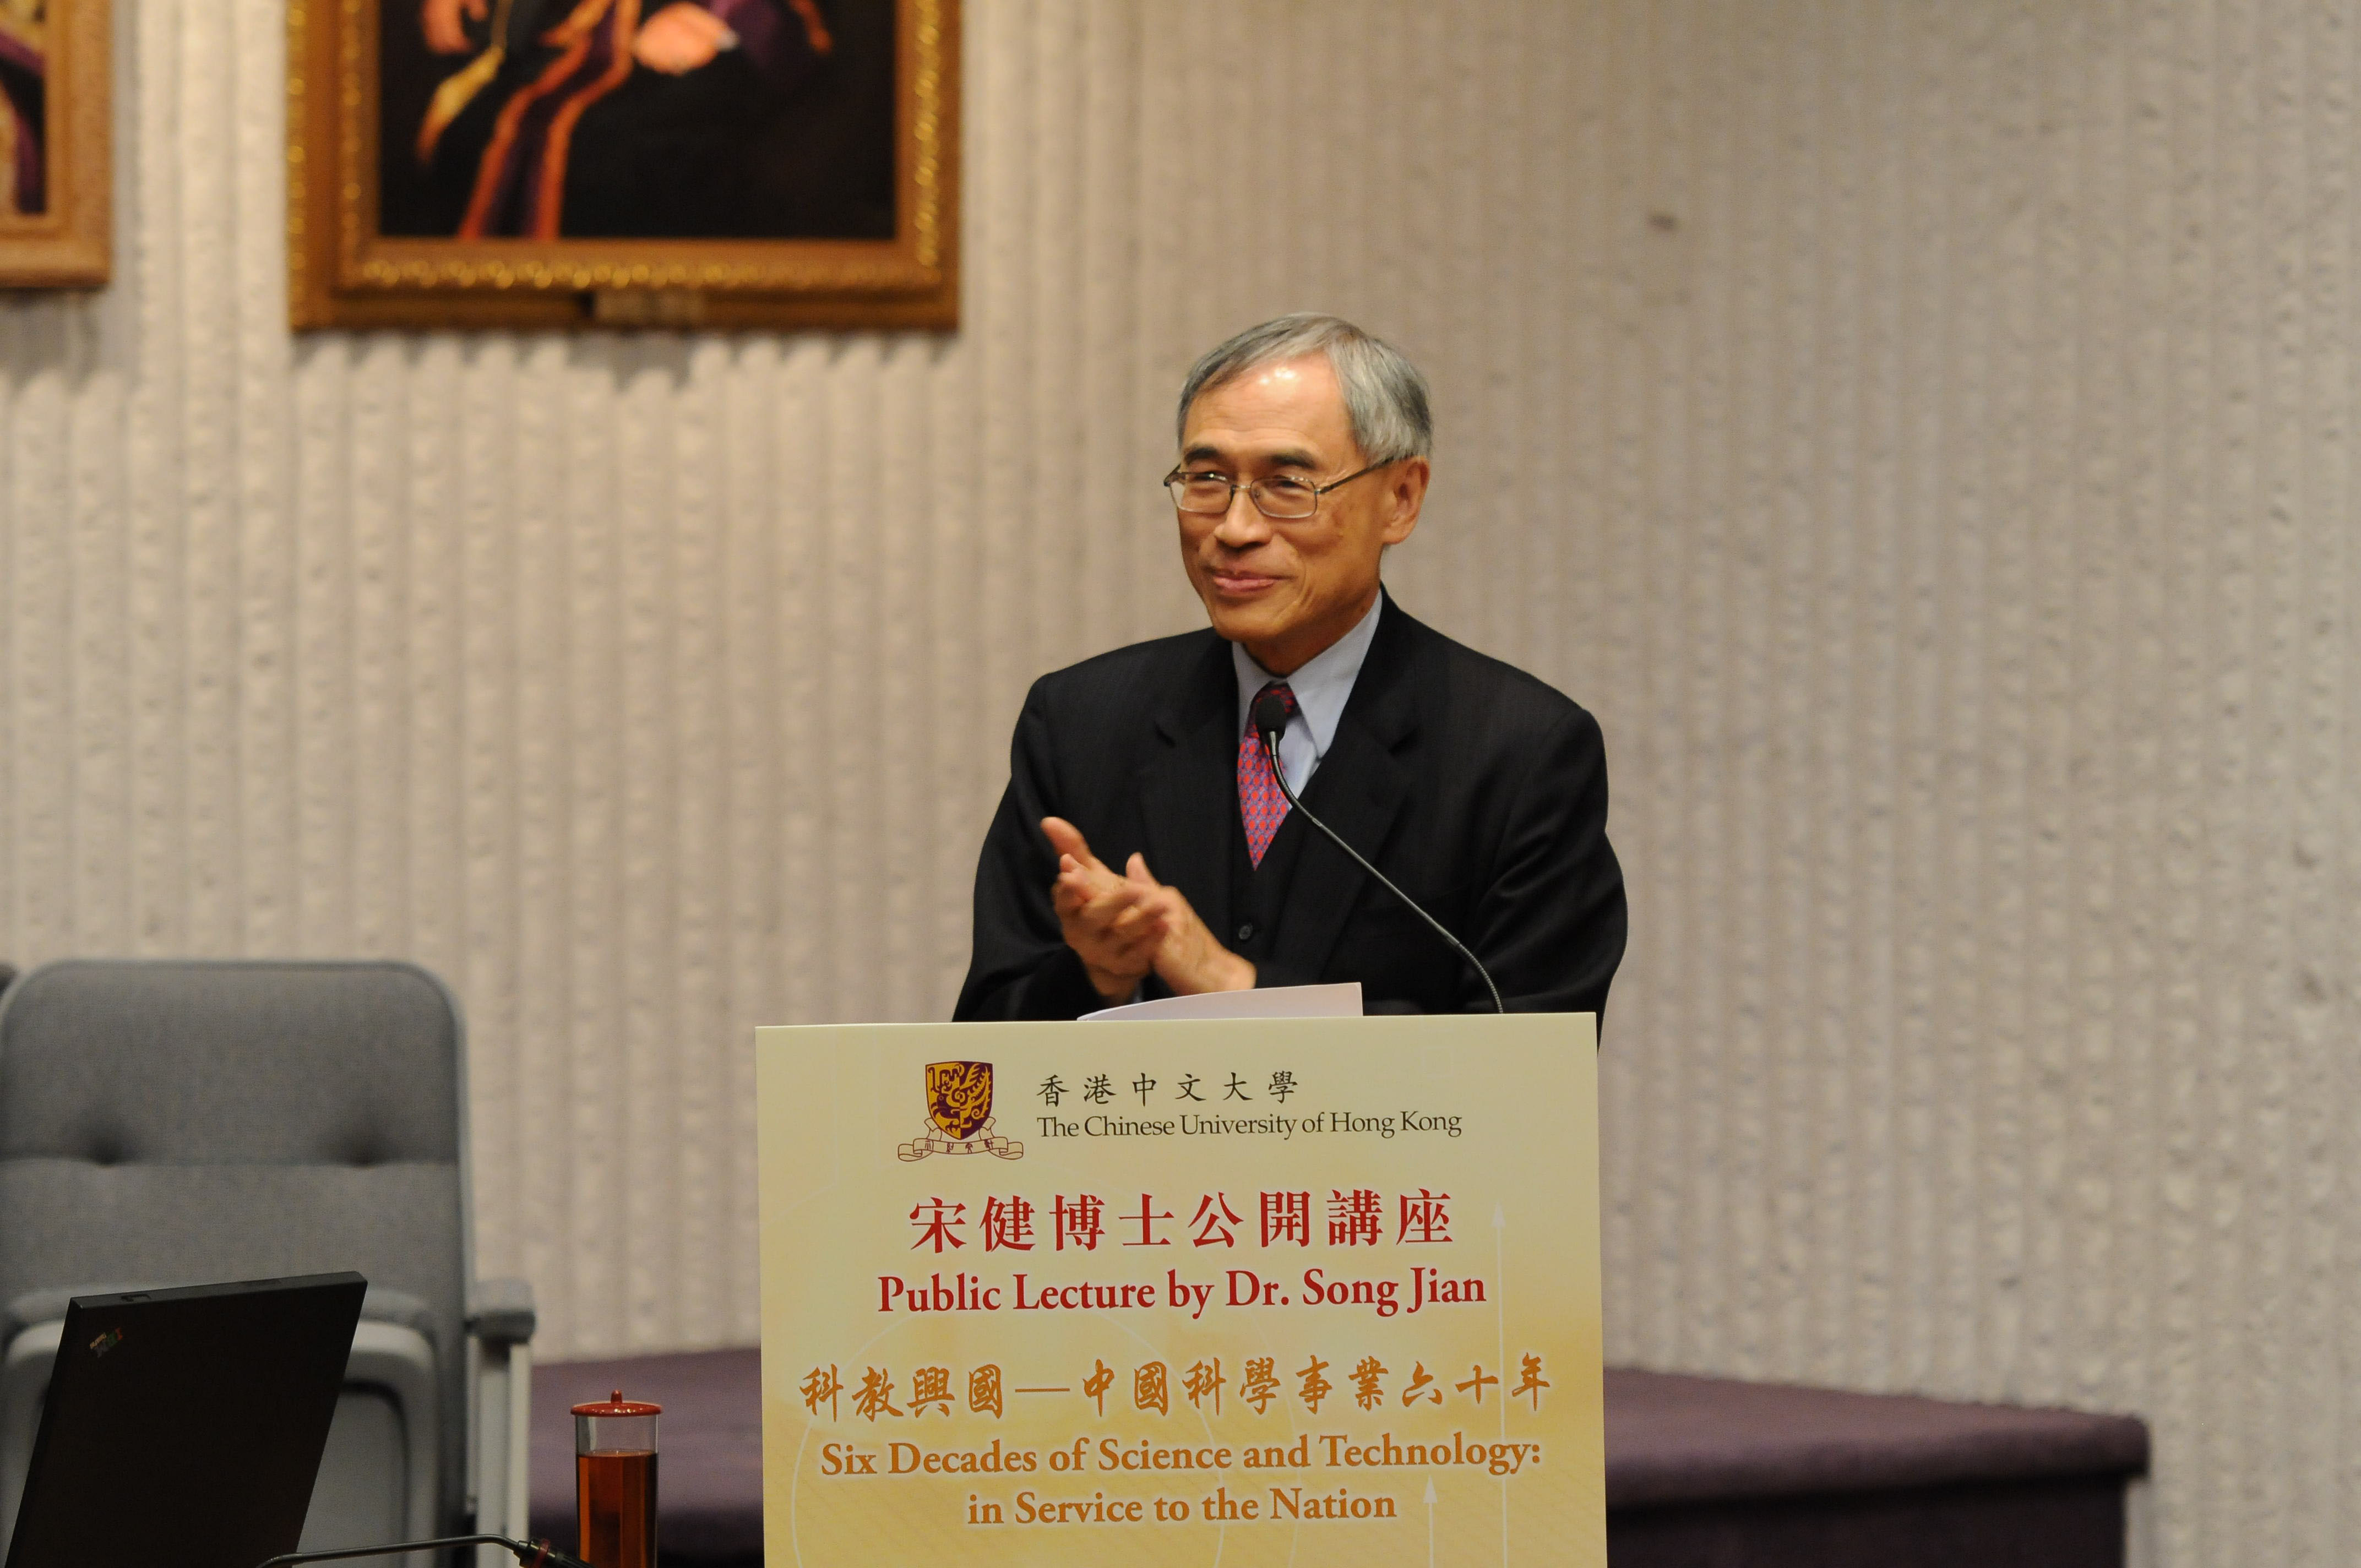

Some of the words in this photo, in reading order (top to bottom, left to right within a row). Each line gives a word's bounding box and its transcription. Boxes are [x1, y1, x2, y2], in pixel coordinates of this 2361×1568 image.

[1036, 1070, 1298, 1107] 香港中文大學
[1037, 1116, 1079, 1139] The
[1084, 1115, 1175, 1136] Chinese
[1179, 1114, 1298, 1141] University
[1301, 1111, 1325, 1134] of
[1330, 1112, 1395, 1139] Hong
[1400, 1110, 1462, 1137] Kong
[909, 1188, 1453, 1254] 宋健博士公開講座
[878, 1272, 1001, 1313] Public
[1013, 1273, 1156, 1310] Lecture
[1168, 1269, 1215, 1320] by
[1226, 1270, 1290, 1307] Dr.
[1302, 1268, 1399, 1317] Song
[1406, 1267, 1487, 1314] Jian
[822, 1443, 878, 1476] Six
[888, 1439, 1037, 1474] Decades
[1049, 1437, 1090, 1472] of
[1098, 1439, 1232, 1471] Science
[1243, 1434, 1311, 1468] and
[1319, 1431, 1539, 1476] Technology:
[967, 1494, 1004, 1525] in
[1015, 1491, 1143, 1524] Service
[1154, 1498, 1189, 1521] to
[1201, 1487, 1259, 1521] the
[1269, 1488, 1397, 1519] Nation
